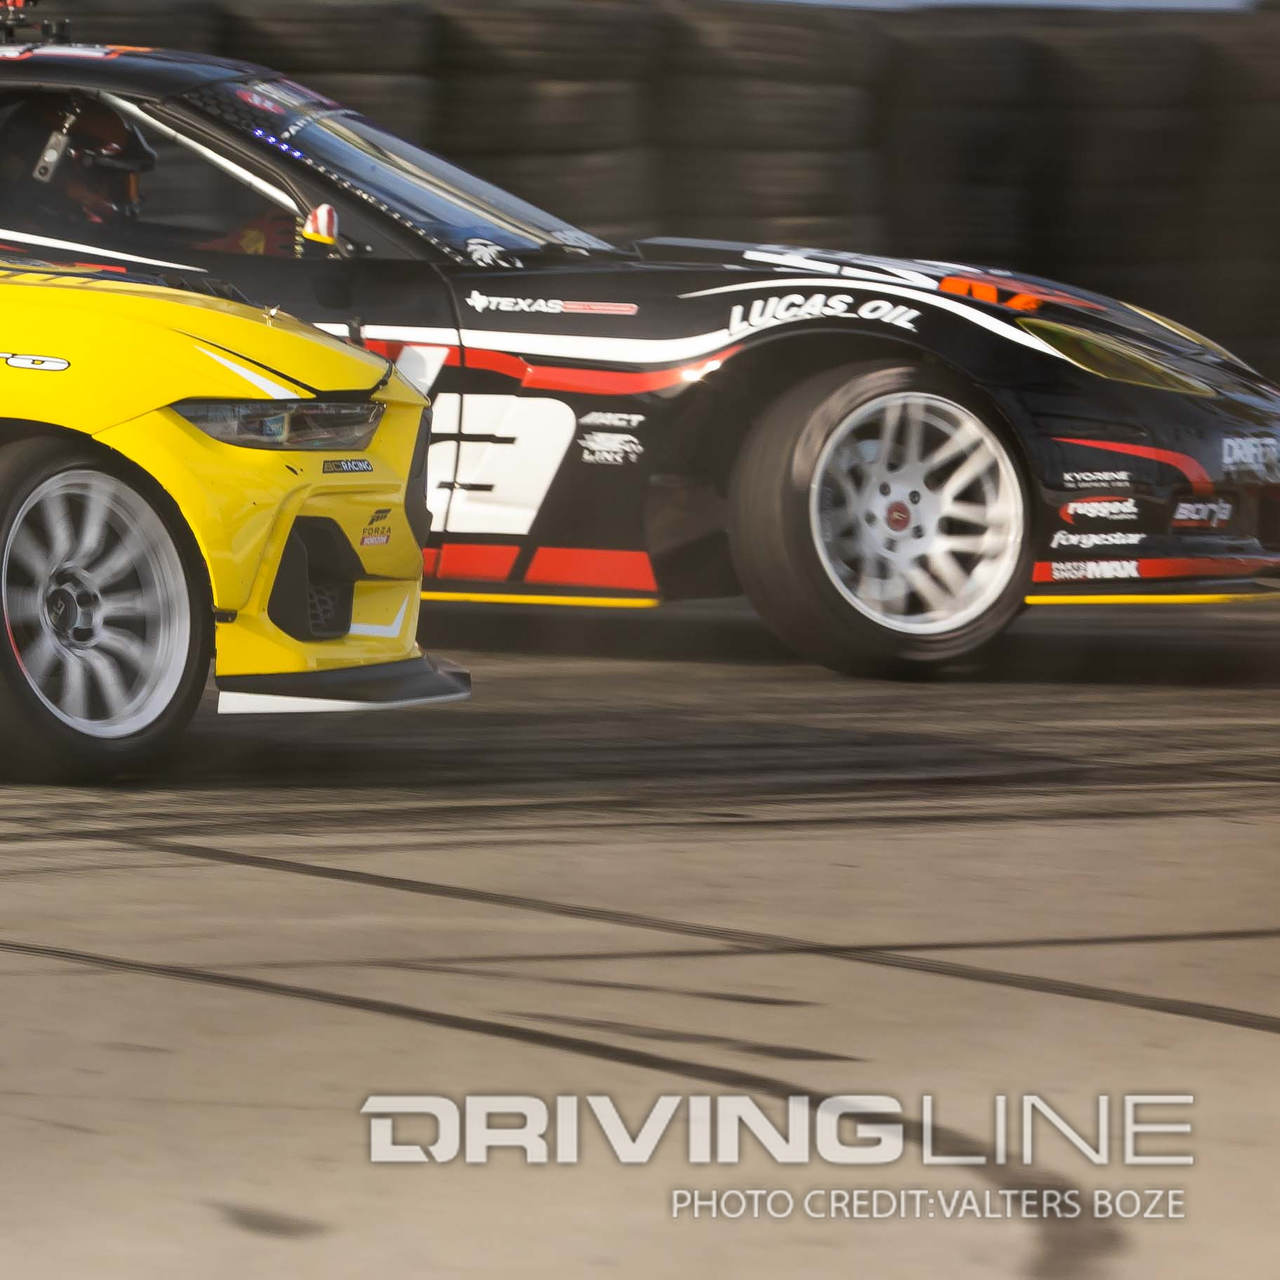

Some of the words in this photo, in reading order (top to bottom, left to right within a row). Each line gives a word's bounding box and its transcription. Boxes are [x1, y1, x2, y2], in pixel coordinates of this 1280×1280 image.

[488, 296, 563, 314] TEXAS
[728, 293, 855, 337] LUCAS
[857, 299, 923, 333] OIL
[362, 527, 392, 535] FORZA
